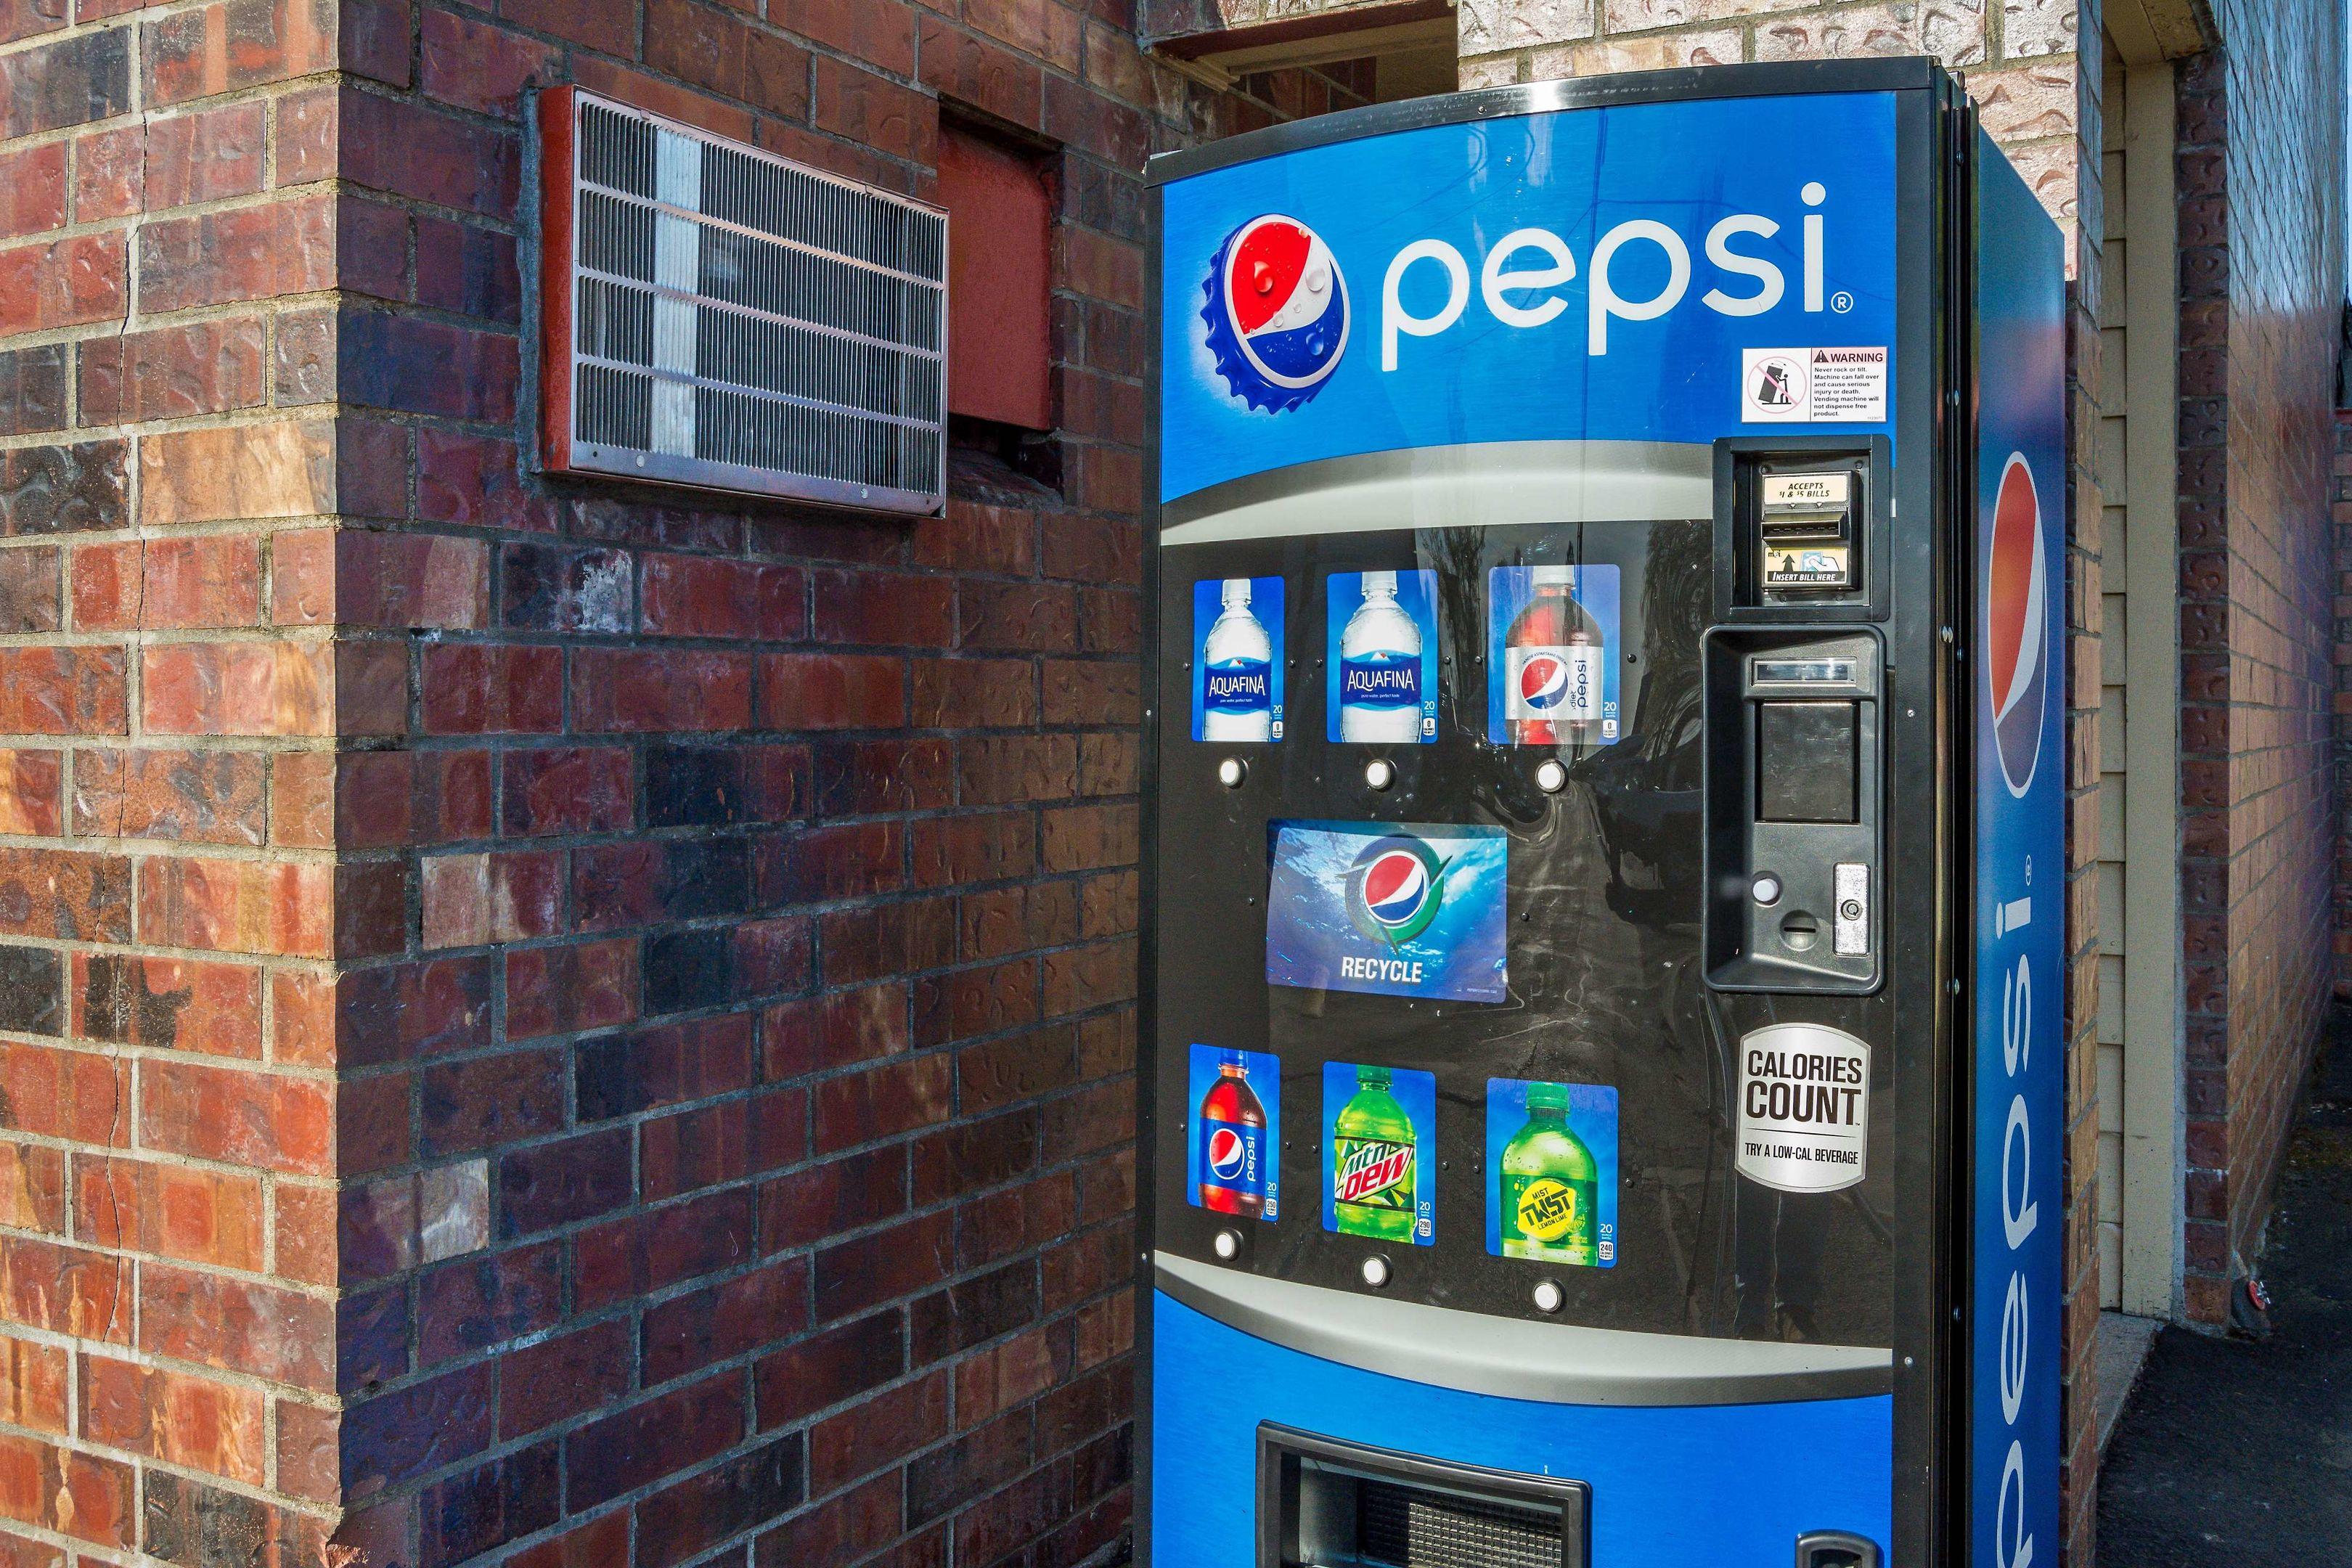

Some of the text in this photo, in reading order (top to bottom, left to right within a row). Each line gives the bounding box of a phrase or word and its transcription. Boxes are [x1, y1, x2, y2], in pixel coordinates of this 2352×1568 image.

[1382, 181, 1823, 372] pepsi
[1830, 353, 1883, 362] WARNING
[1772, 572, 1798, 581] INSERT
[1209, 674, 1265, 697] AQUAFINA
[1347, 669, 1415, 692] AQUAFINA
[1575, 660, 1588, 708] pepsi
[1273, 705, 1283, 714] 20
[1424, 701, 1434, 710] 20
[1604, 701, 1617, 711] 20
[1342, 957, 1423, 983] RECYCLE
[1747, 1050, 1862, 1085] CALORIES
[1746, 1080, 1861, 1125] COUNT
[1246, 1136, 1257, 1182] pepsi
[1745, 1143, 1858, 1164] TRY A LOW-CAL BEVERAGE
[1267, 1182, 1276, 1191] 20
[1532, 1188, 1549, 1200] MIST
[1420, 1201, 1430, 1211] 20
[1538, 1213, 1567, 1230] LEMON LIME
[1600, 1223, 1613, 1233] 20
